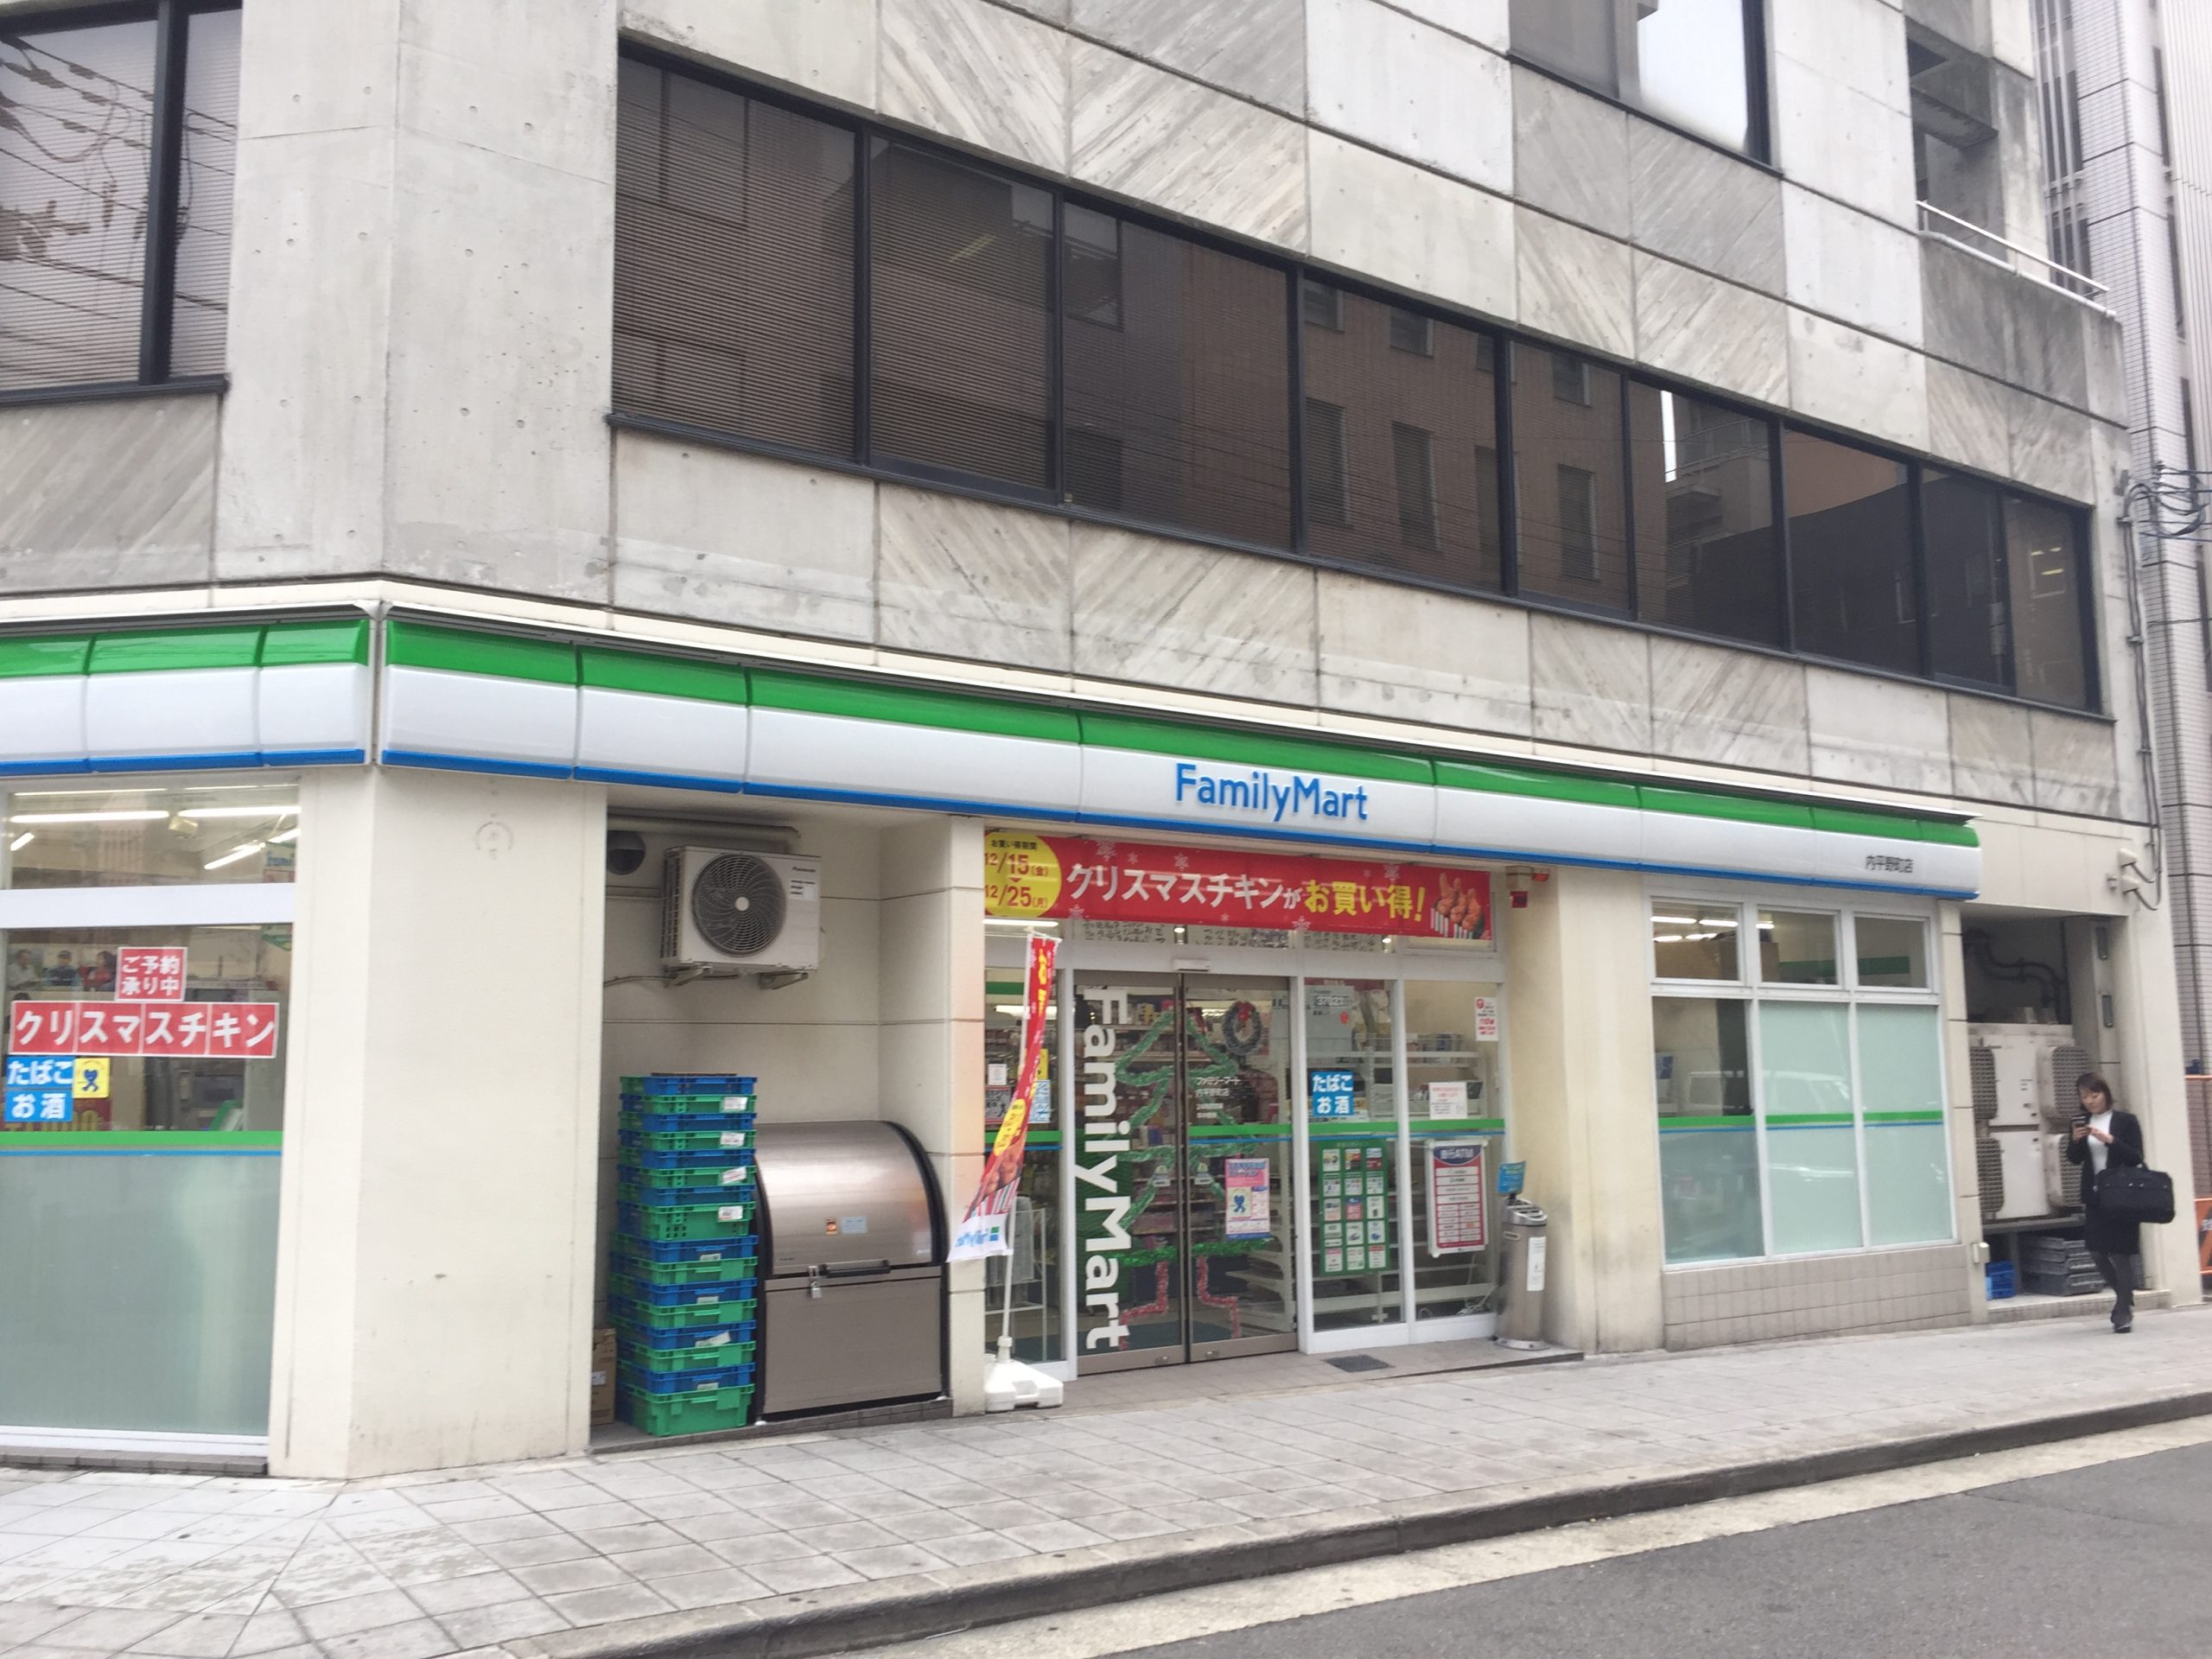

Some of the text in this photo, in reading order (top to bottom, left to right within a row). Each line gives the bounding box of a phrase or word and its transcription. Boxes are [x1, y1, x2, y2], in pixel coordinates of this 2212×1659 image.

[1176, 763, 1367, 822] FamilyMart
[122, 955, 181, 975] ご予約
[121, 976, 180, 995] 承り中
[16, 1009, 275, 1047] クリスマスチキン
[7, 1059, 73, 1085] たばこ
[1313, 1074, 1354, 1092] たばこ
[11, 1093, 67, 1119] お酒
[1317, 1096, 1350, 1114] お酒
[1075, 988, 1132, 1350] FamilyMart
